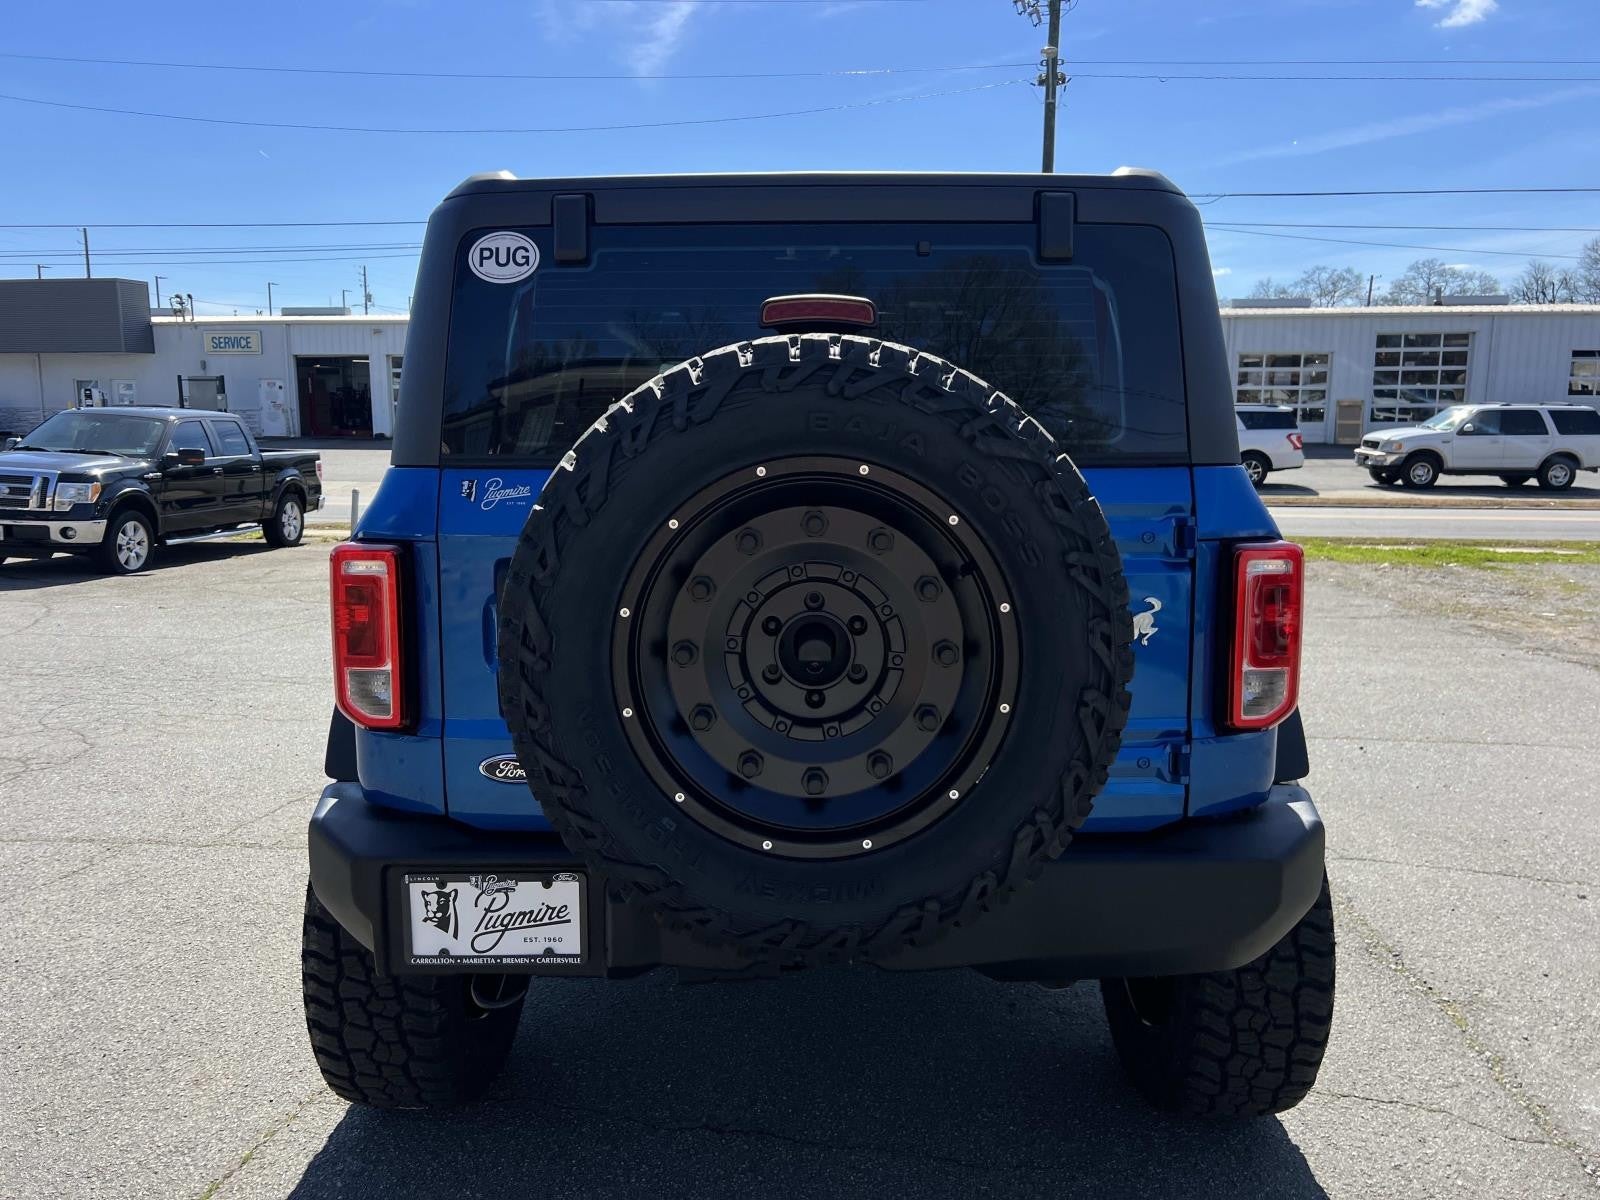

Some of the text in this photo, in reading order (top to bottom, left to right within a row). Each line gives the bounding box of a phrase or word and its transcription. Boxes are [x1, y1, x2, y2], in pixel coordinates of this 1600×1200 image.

[479, 246, 530, 268] PUG
[211, 335, 253, 350] SERVICE
[807, 409, 927, 457] BAJA
[481, 477, 531, 511] Pugmire
[495, 760, 527, 778] For
[470, 891, 572, 954] Pugmire
[523, 936, 563, 944] EST. 1960
